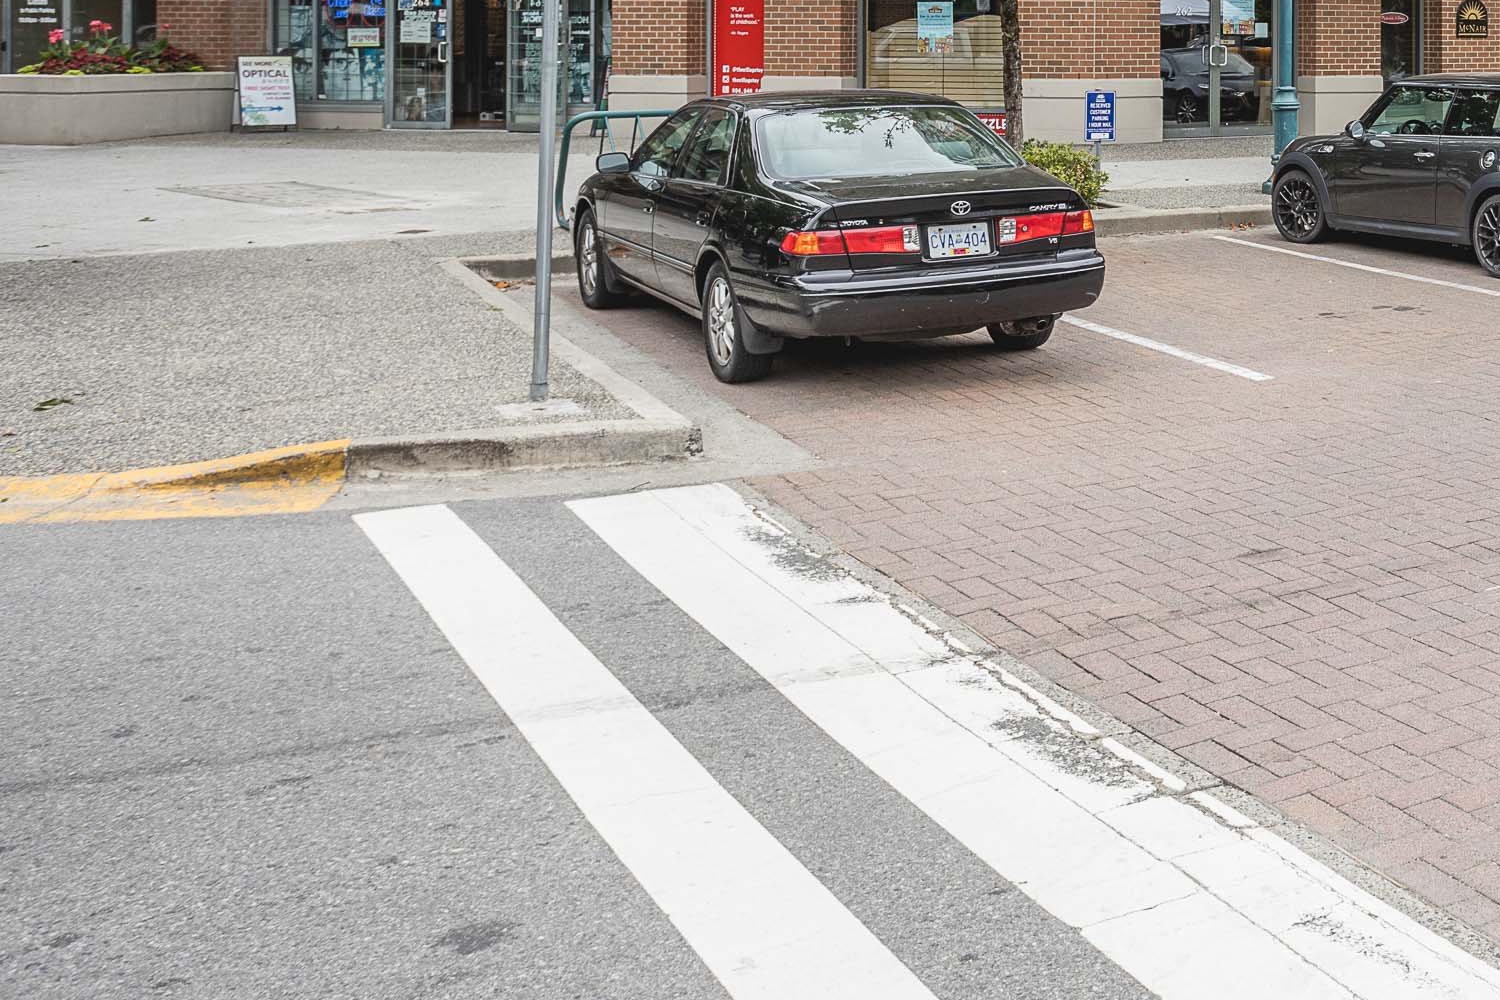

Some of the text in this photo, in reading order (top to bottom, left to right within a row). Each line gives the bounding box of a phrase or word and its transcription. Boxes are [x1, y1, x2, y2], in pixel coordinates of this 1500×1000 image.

[1175, 6, 1193, 17] 262
[242, 69, 289, 78] OPTICAL
[1028, 203, 1059, 212] CAMRY
[842, 219, 869, 227] TOYOTA
[930, 233, 955, 249] CVA
[963, 231, 987, 247] 404
